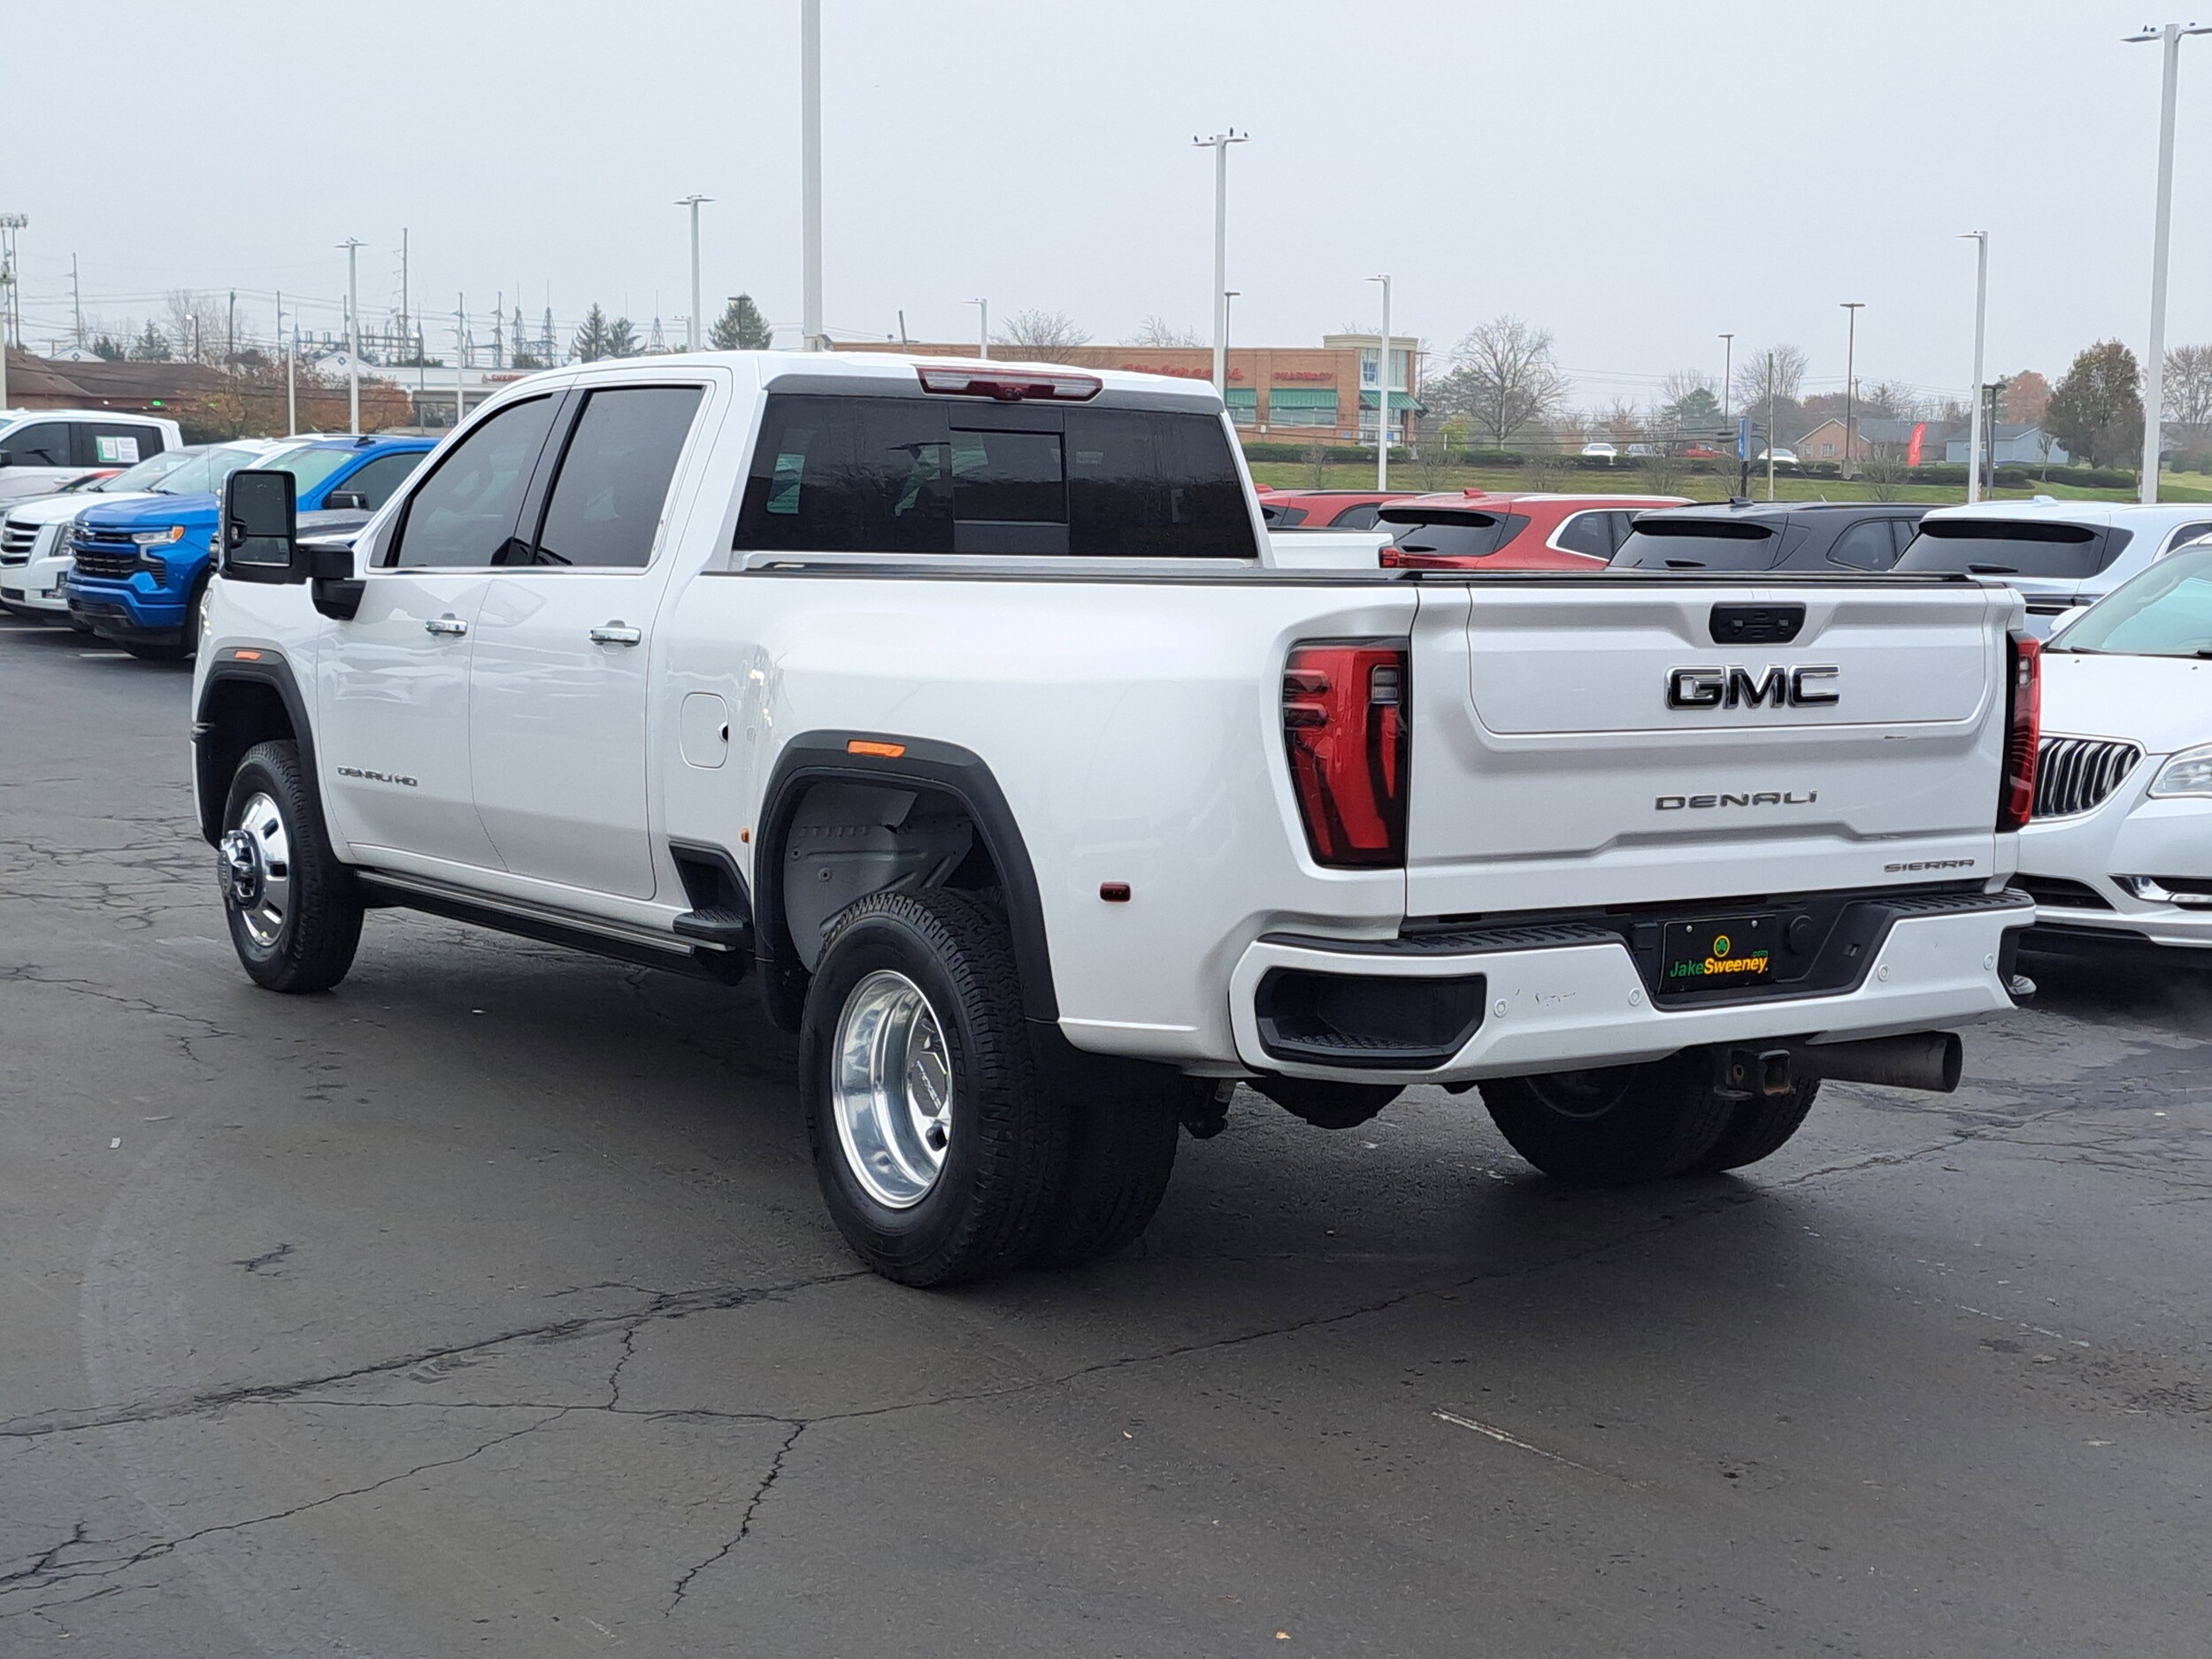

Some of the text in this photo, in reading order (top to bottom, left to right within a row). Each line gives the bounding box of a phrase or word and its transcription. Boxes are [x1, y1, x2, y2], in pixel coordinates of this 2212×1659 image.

[1663, 664, 1840, 710] GMC
[336, 765, 419, 787] DENALI HD
[1655, 789, 1818, 810] DENALI
[1884, 859, 1975, 872] SIERRA
